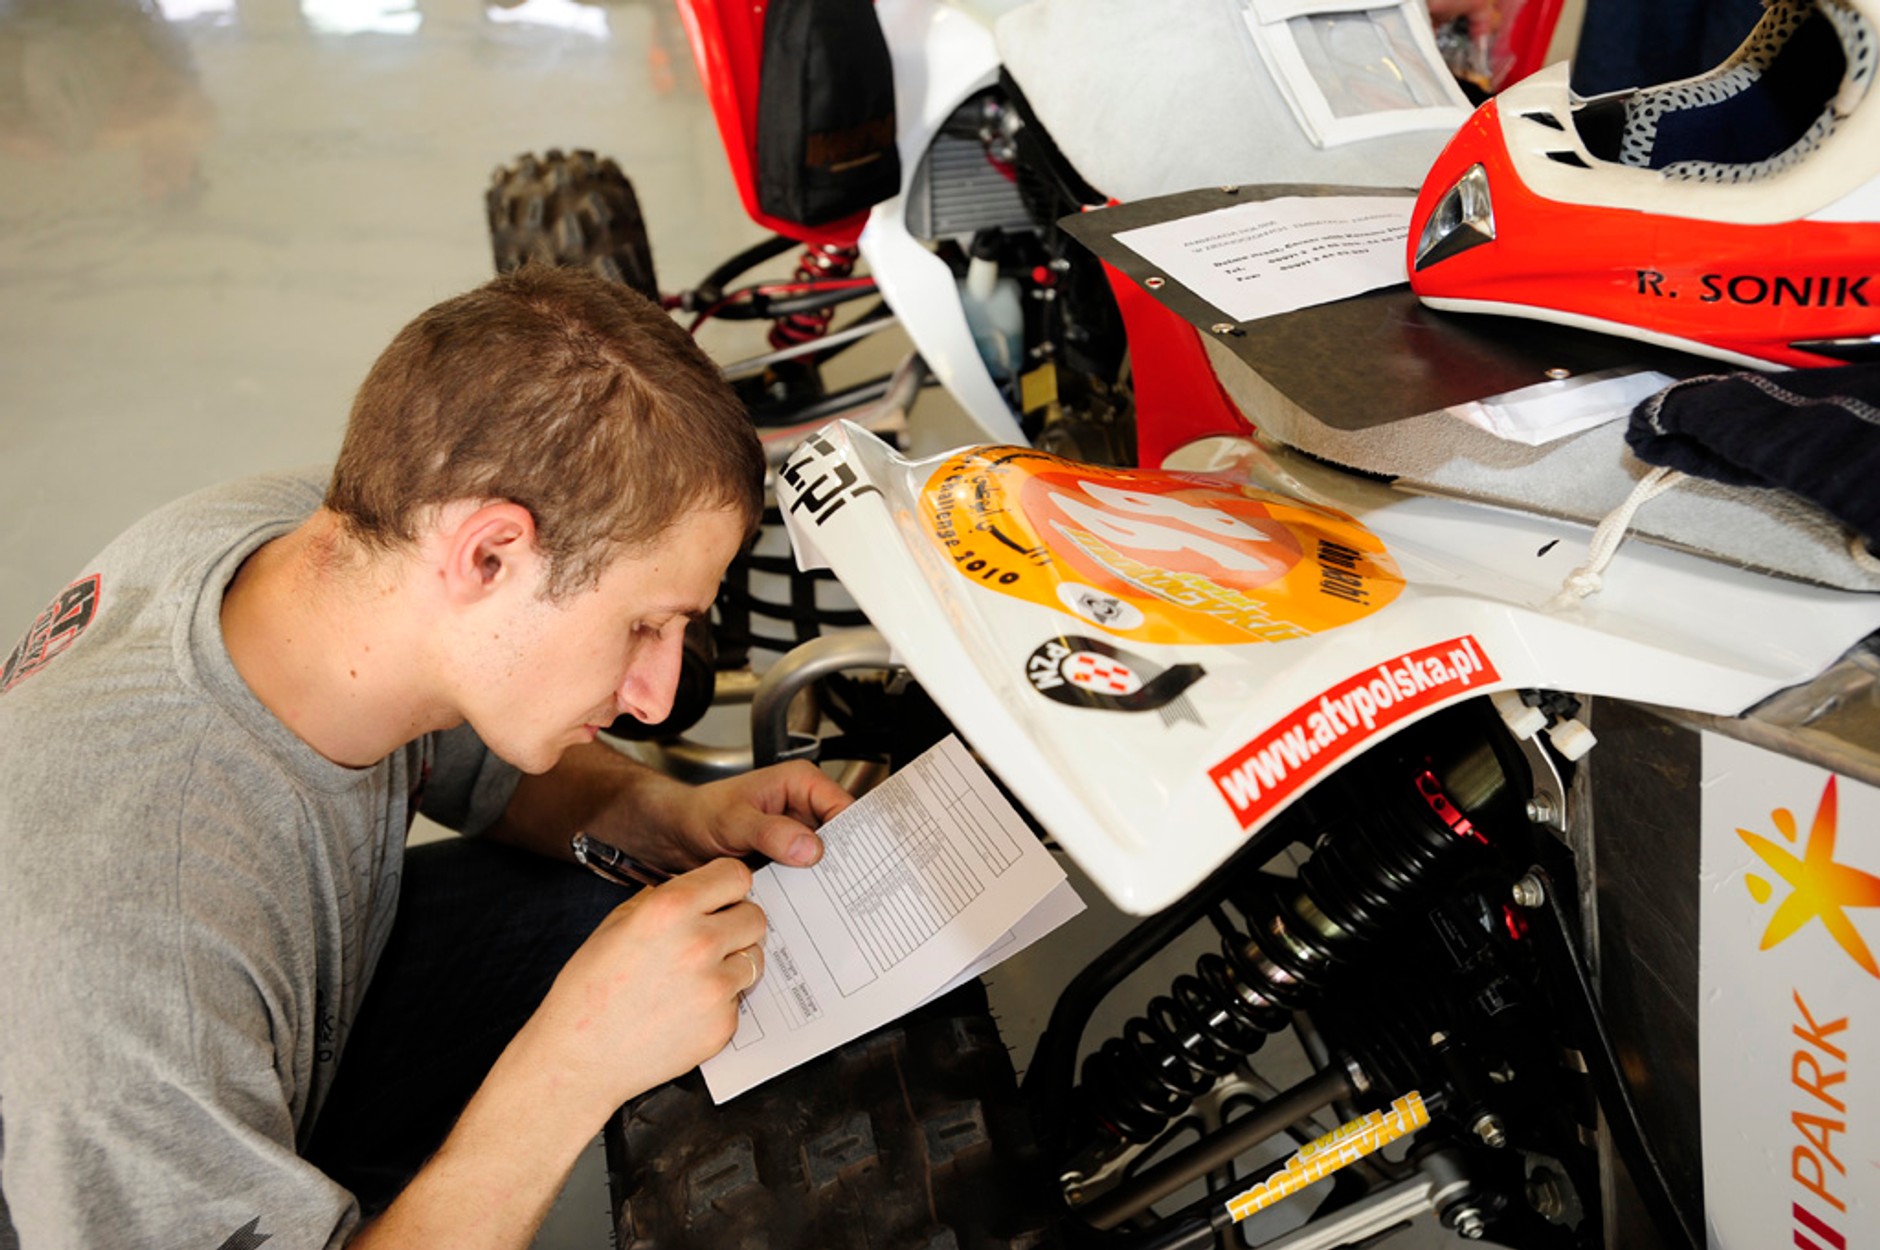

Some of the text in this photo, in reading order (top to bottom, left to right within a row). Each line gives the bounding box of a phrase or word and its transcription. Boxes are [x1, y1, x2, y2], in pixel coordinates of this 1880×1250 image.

[1636, 269, 1872, 308] R. SONIK
[1219, 637, 1484, 811] www.atvpolska.pl
[1791, 987, 1848, 1214] PARK
